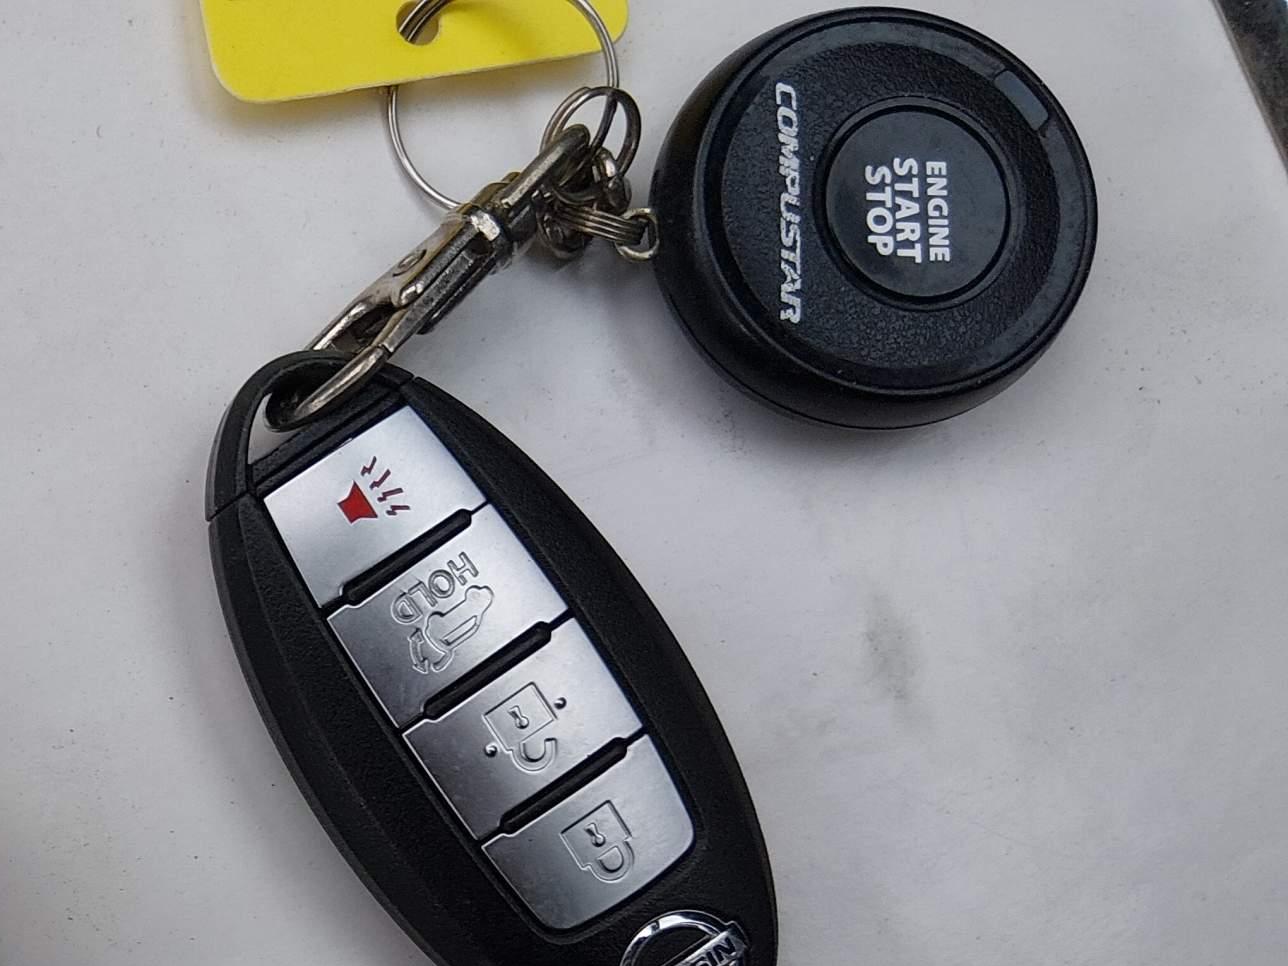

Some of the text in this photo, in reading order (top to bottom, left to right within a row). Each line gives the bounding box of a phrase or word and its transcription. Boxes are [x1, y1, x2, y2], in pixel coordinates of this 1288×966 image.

[774, 81, 802, 325] COMPUSTAR
[864, 165, 894, 256] STOP
[893, 157, 922, 264] START
[925, 160, 951, 263] ENGINE
[390, 551, 479, 625] HOLD
